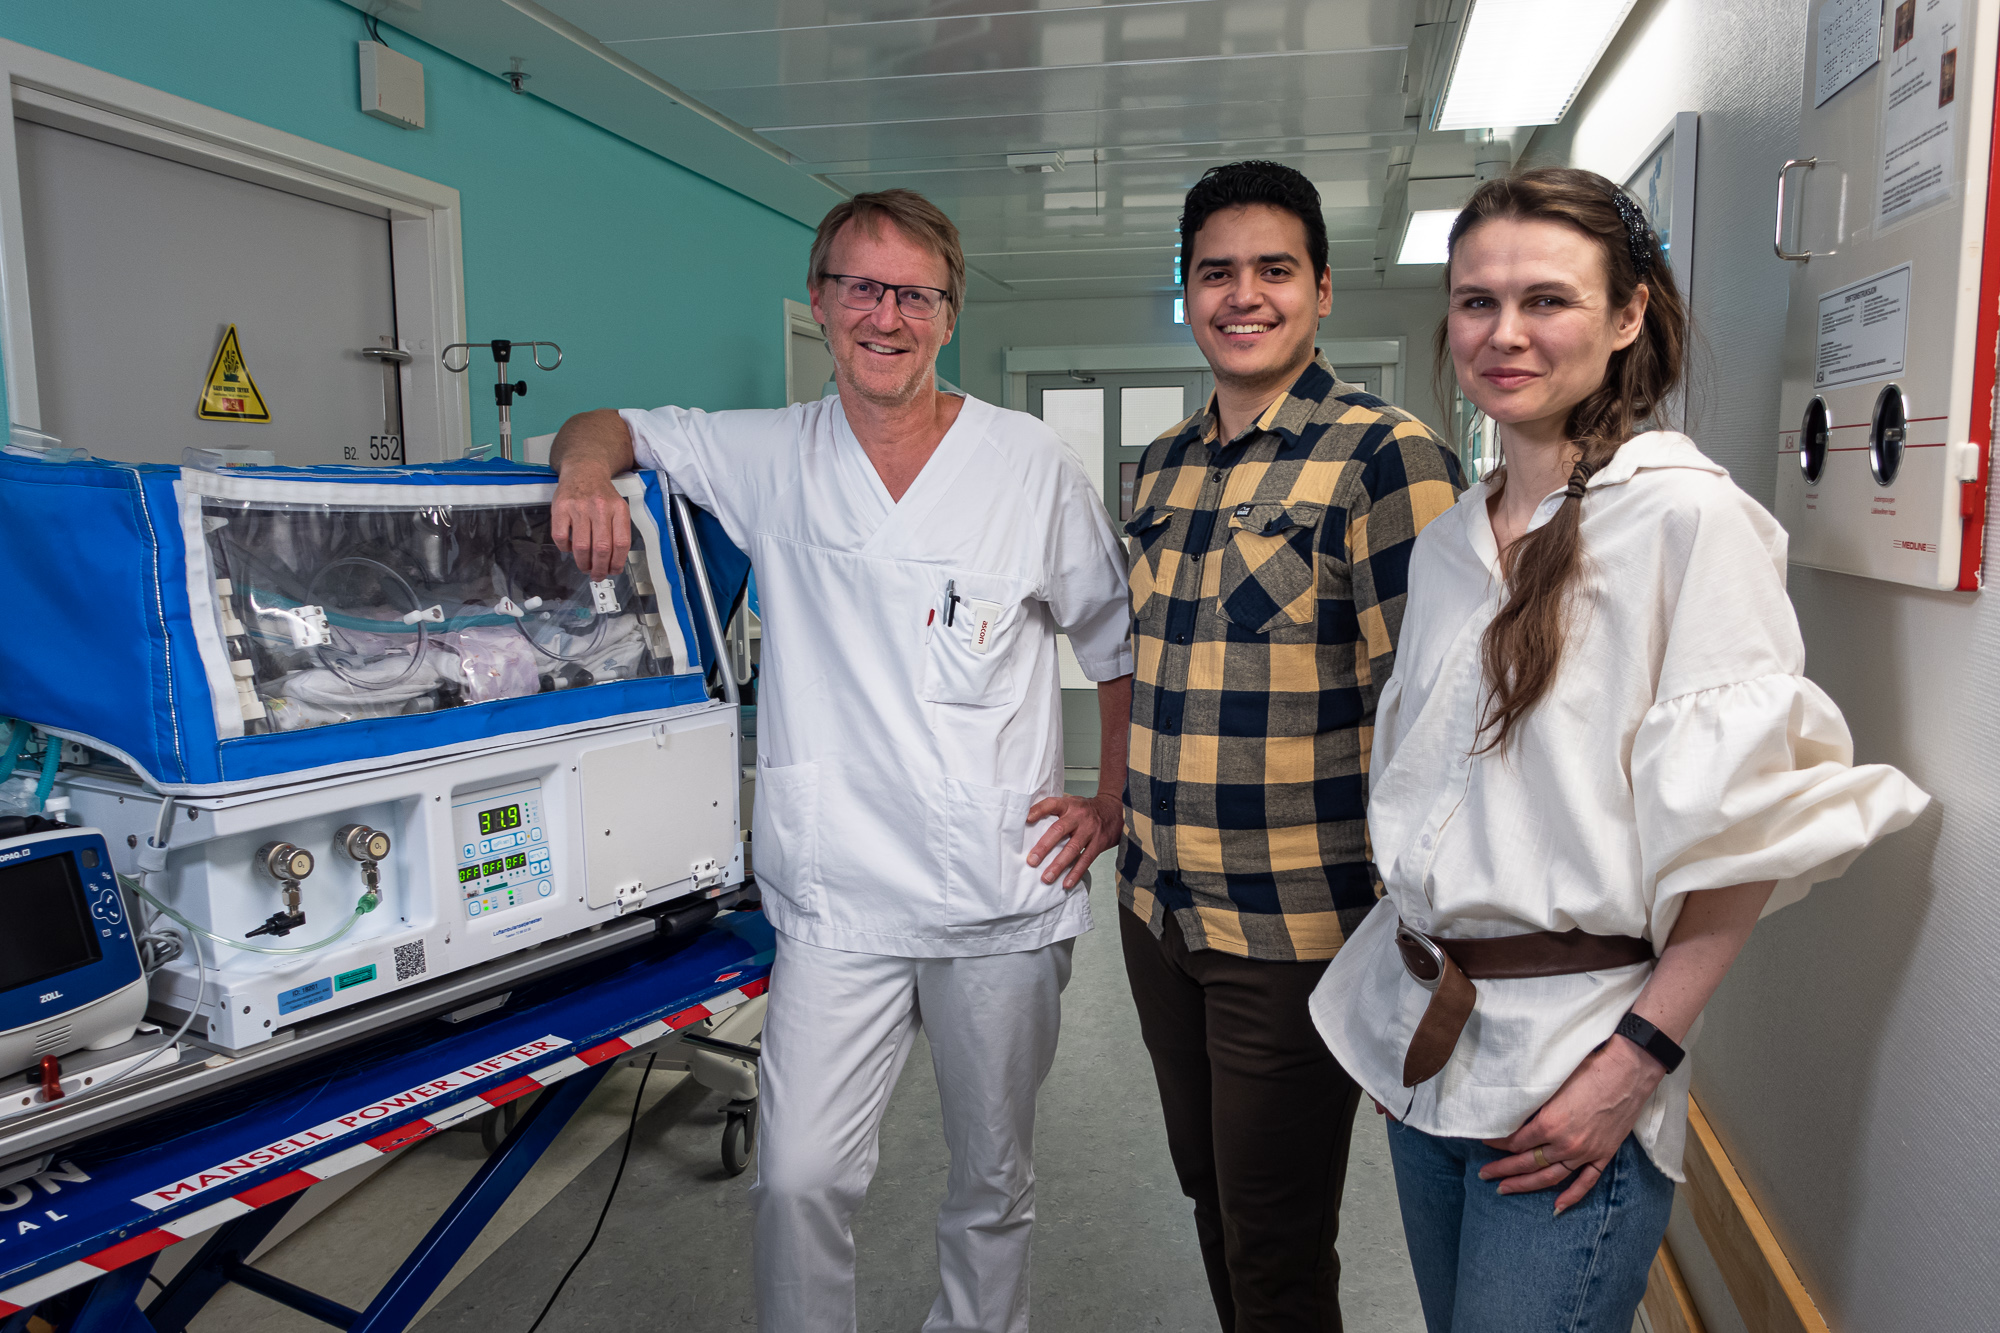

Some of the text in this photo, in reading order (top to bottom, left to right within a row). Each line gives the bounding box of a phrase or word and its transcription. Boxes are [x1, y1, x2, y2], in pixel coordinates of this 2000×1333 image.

[370, 435, 400, 460] 552
[1785, 436, 1794, 449] AGA
[1901, 541, 1926, 551] MEDILINE
[978, 620, 988, 645] ascom
[459, 866, 479, 882] OFF
[482, 860, 502, 876] OFF
[505, 854, 525, 869] OFF
[39, 990, 63, 1003] ZOLL
[154, 1040, 559, 1201] MANSELL POWER LIFTER
